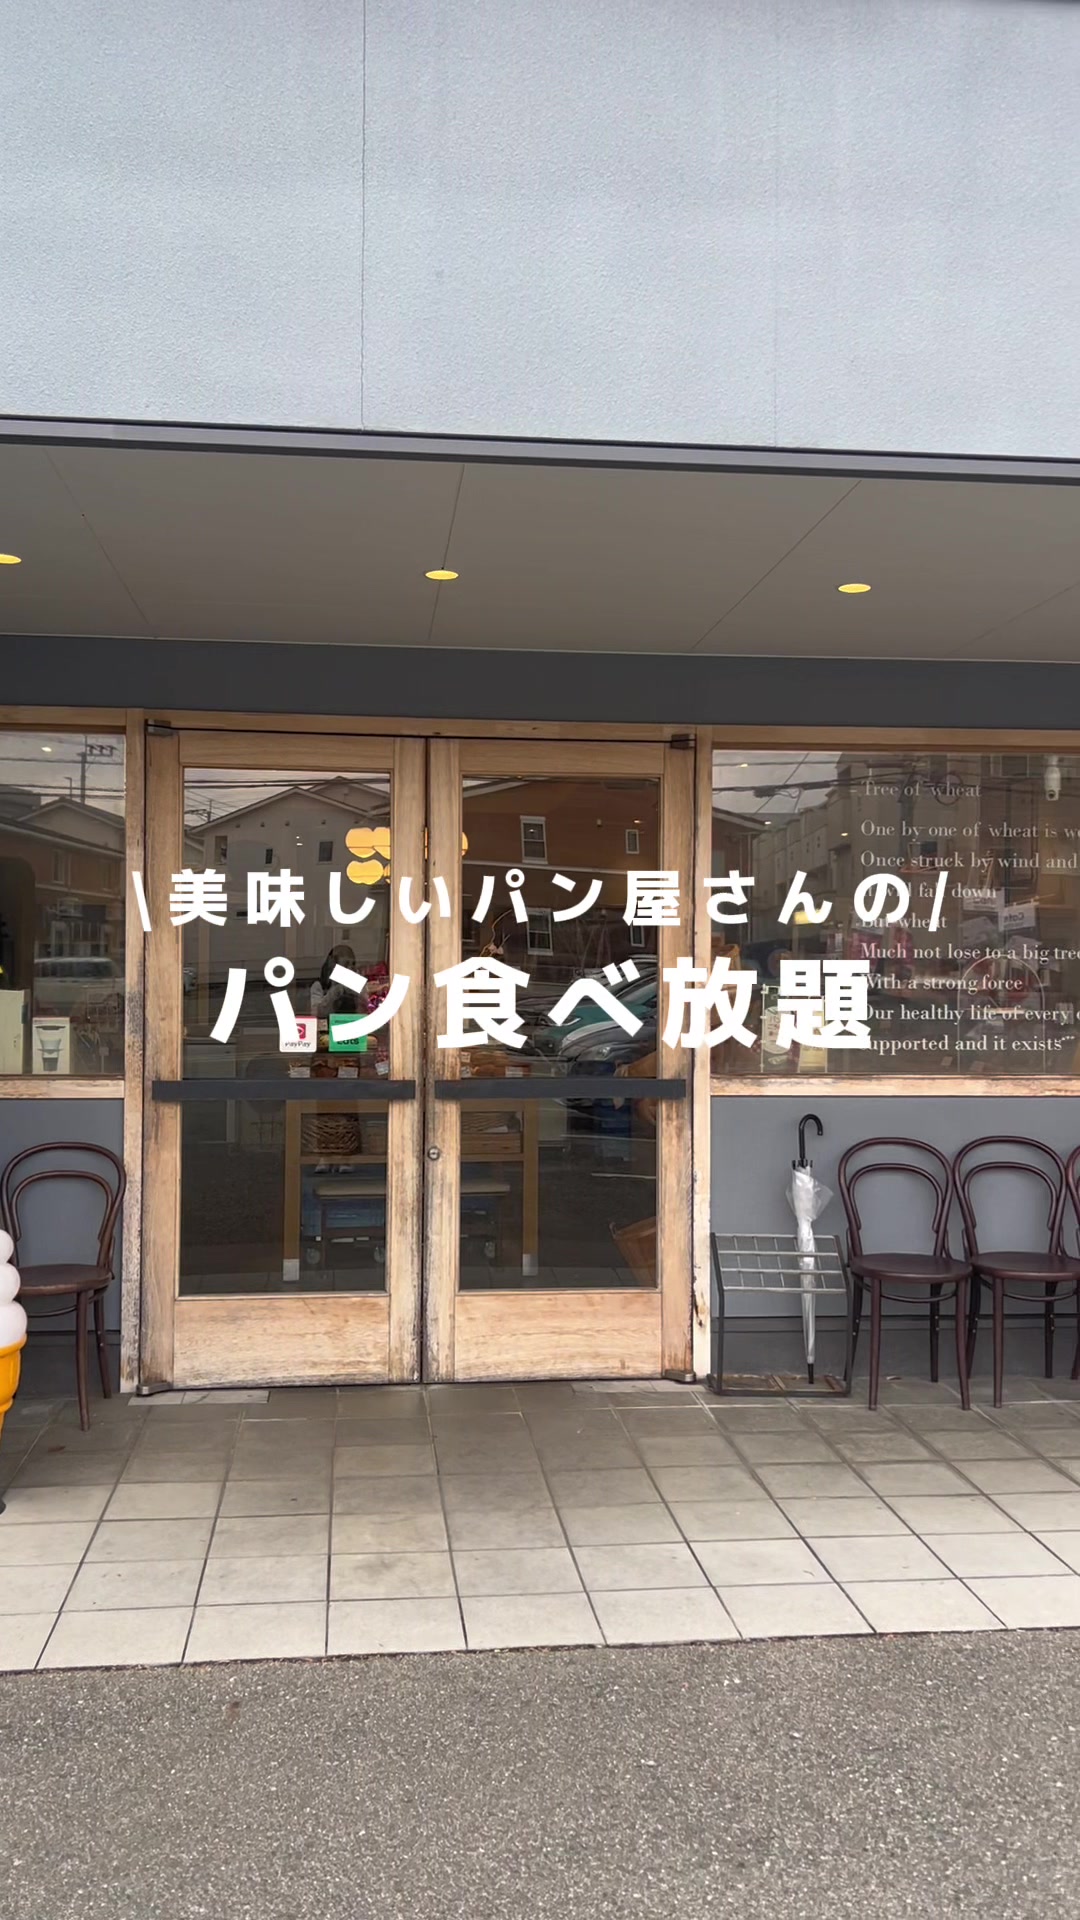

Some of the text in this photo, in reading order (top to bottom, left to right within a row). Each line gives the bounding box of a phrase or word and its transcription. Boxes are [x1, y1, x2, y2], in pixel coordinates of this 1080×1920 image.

[861, 780, 981, 797] Tree of wheat
[861, 819, 896, 836] One
[902, 820, 922, 842] by
[928, 826, 957, 837] one
[963, 821, 982, 837] of
[989, 822, 1039, 838] wheat
[1045, 823, 1058, 838] is
[861, 850, 1078, 873] Once struck by wind and
[919, 881, 946, 898] fa
[951, 881, 997, 898] down
[898, 912, 948, 929] whet
[861, 942, 907, 959] Much
[913, 946, 942, 959] not
[948, 943, 981, 959] lose
[986, 947, 1001, 959] to
[1007, 949, 1016, 959] a
[1023, 944, 1050, 965] big
[908, 978, 918, 989] a
[923, 975, 978, 995] strong
[982, 974, 1023, 990] force
[900, 1004, 964, 1025] healthy
[970, 1004, 998, 1020] life
[1002, 1005, 1021, 1020] of
[1025, 1010, 1069, 1025] every
[864, 1035, 949, 1056] upported
[955, 1035, 987, 1051] and
[993, 1035, 1007, 1051] it
